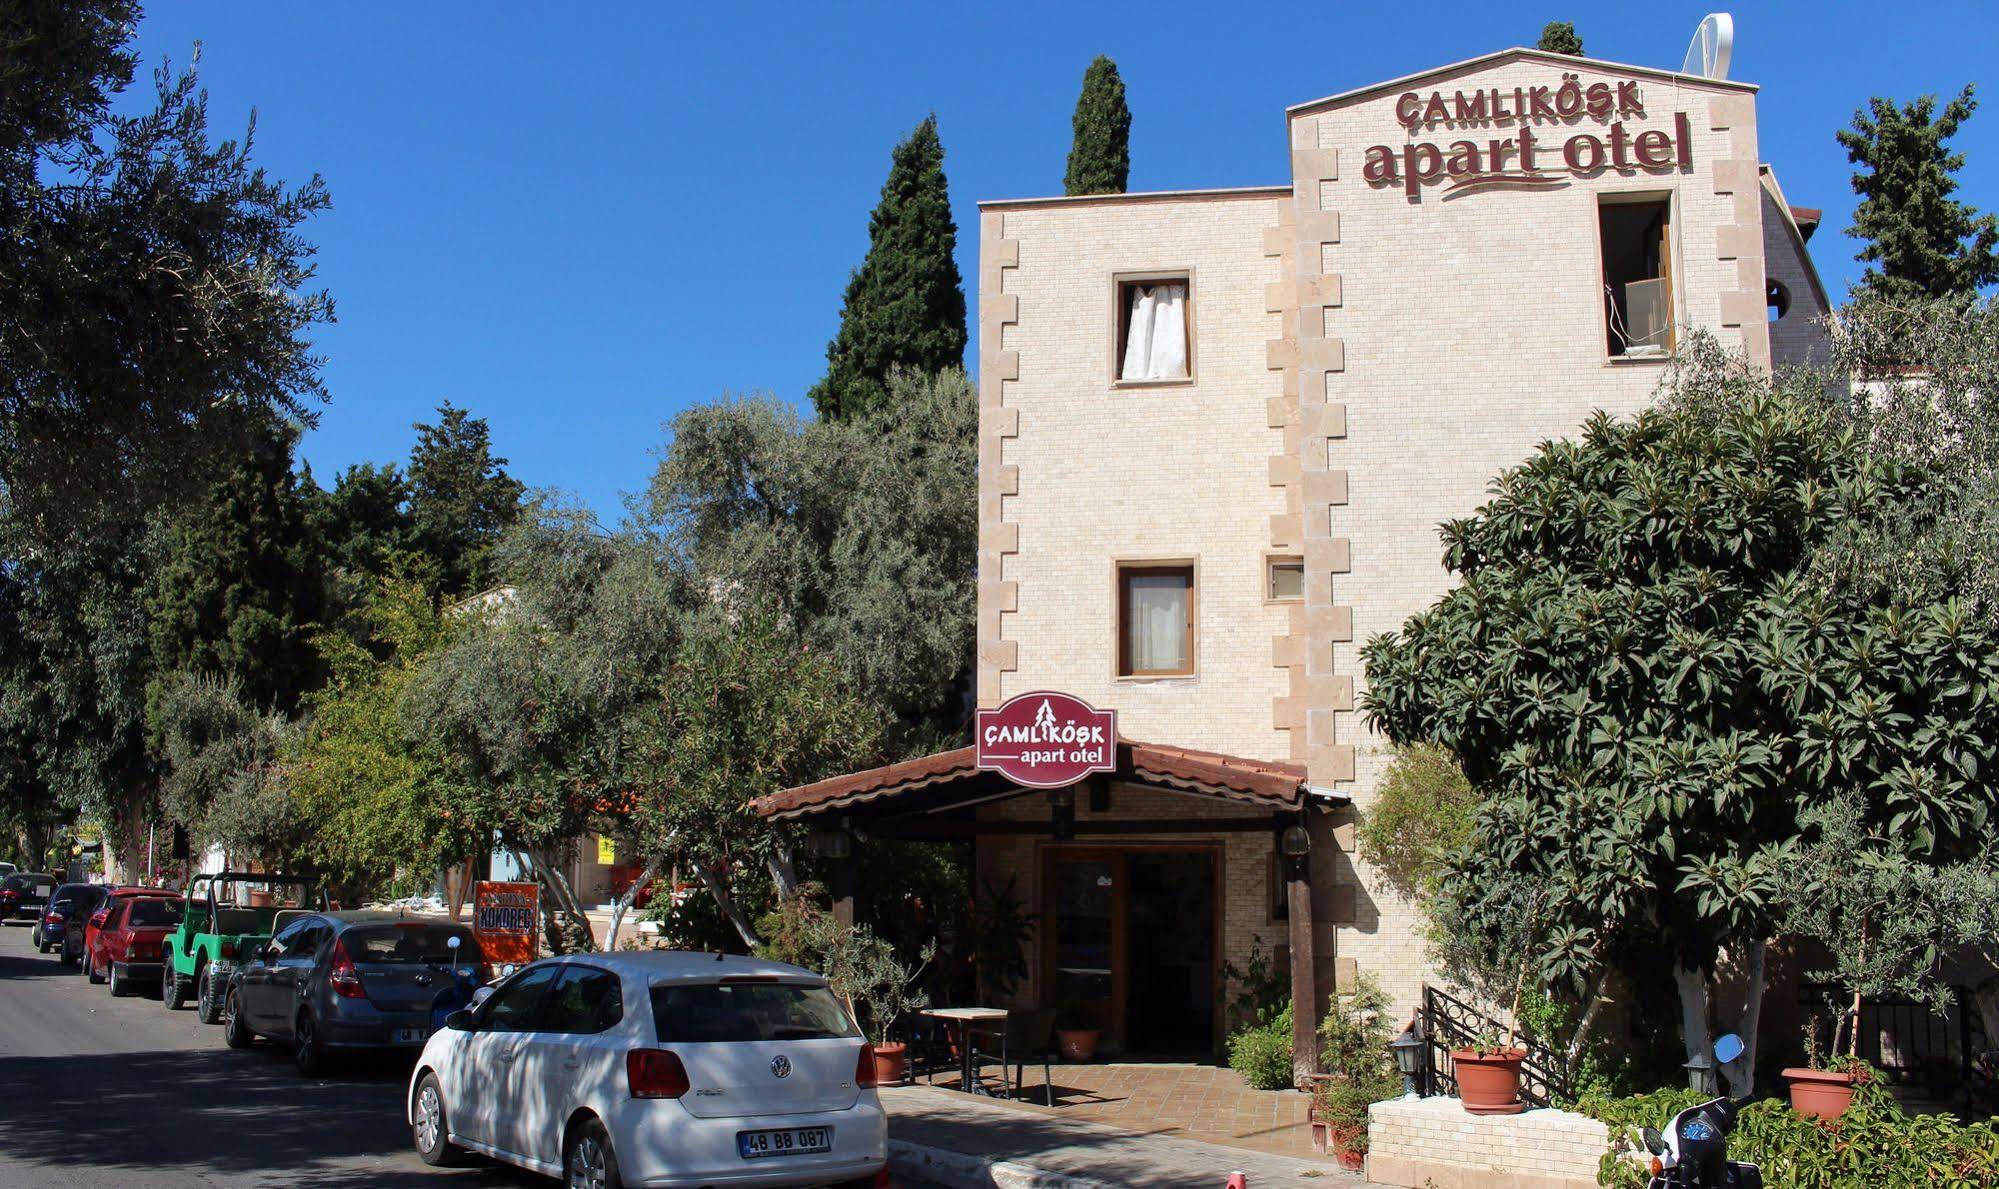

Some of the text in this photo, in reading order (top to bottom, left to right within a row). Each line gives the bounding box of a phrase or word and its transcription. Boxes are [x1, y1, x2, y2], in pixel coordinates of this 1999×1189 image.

[1363, 112, 1691, 197] apart otel
[1020, 746, 1103, 767] apart otel
[749, 1129, 825, 1151] 48 BB 087
